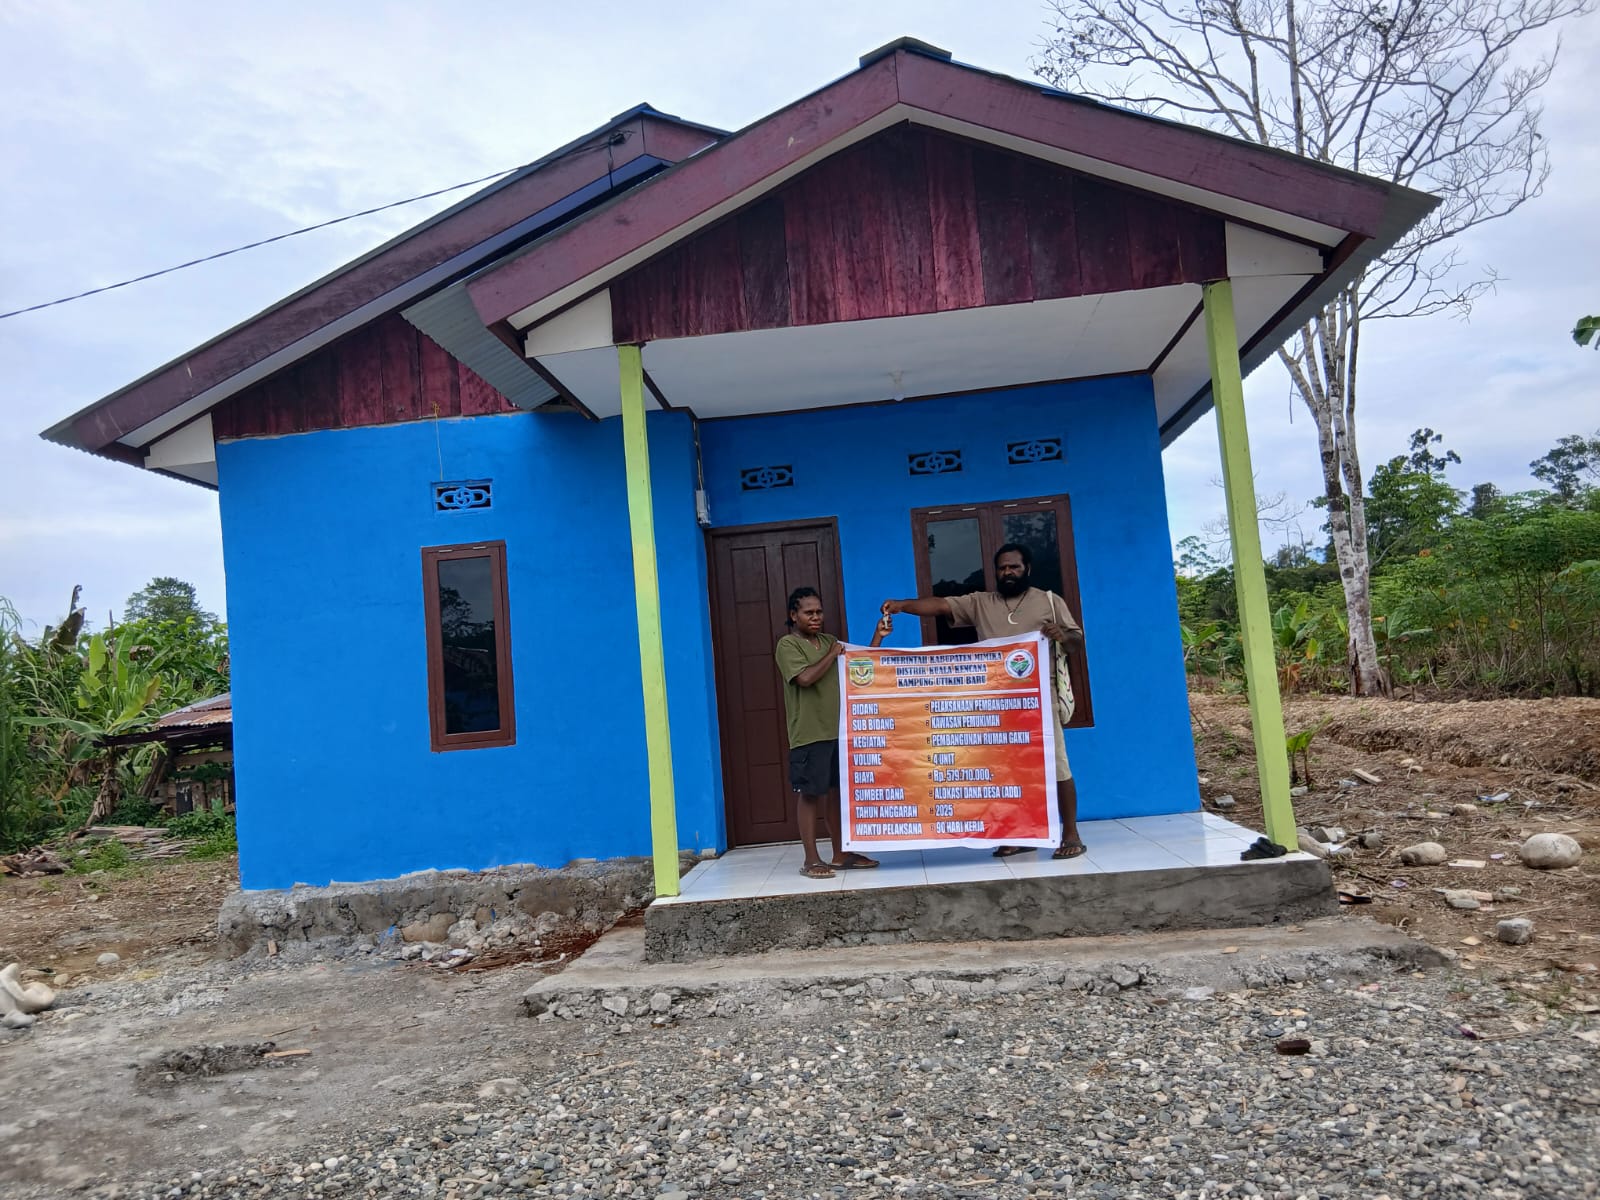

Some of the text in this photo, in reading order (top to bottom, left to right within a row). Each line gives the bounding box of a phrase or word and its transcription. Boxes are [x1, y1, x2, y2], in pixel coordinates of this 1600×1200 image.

[896, 664, 986, 676] DISTRIK KUALA KENCANA
[898, 678, 934, 688] KAMPUNG
[966, 675, 986, 684] BARU
[852, 704, 878, 716] BIDANG
[930, 700, 974, 712] PELAKSANAAN
[974, 698, 1022, 710] PEMBANGUNAN
[1022, 696, 1039, 708] DESA
[852, 719, 867, 731] SUB
[868, 718, 895, 730] BIDANG
[931, 716, 962, 728] KAWASAN
[962, 714, 1000, 727] PEMUKIMAN
[853, 736, 886, 748] KEGIATAN
[932, 734, 982, 746] PEMBANGUNAN
[983, 732, 1008, 744] RUMAH
[1008, 731, 1030, 744] GAKIN
[854, 754, 882, 766] VOLUME
[934, 754, 938, 765] 4
[940, 752, 955, 765] UNIT
[854, 771, 875, 784] BIAYA
[854, 789, 884, 801] SUMBER
[885, 788, 904, 800] DANA
[934, 787, 962, 800] ALOKASI
[964, 786, 982, 798] DANA
[983, 786, 1000, 798] DESA
[1002, 786, 1022, 798] (ADD)
[855, 806, 879, 818] TAHUN
[880, 804, 918, 818] ANGGARAN
[936, 804, 954, 817] 2025
[856, 824, 882, 836] WAKTU
[882, 822, 923, 835] PELAKSANA
[936, 822, 946, 834] 90
[946, 821, 964, 833] HARI
[964, 820, 985, 832] KERJA
